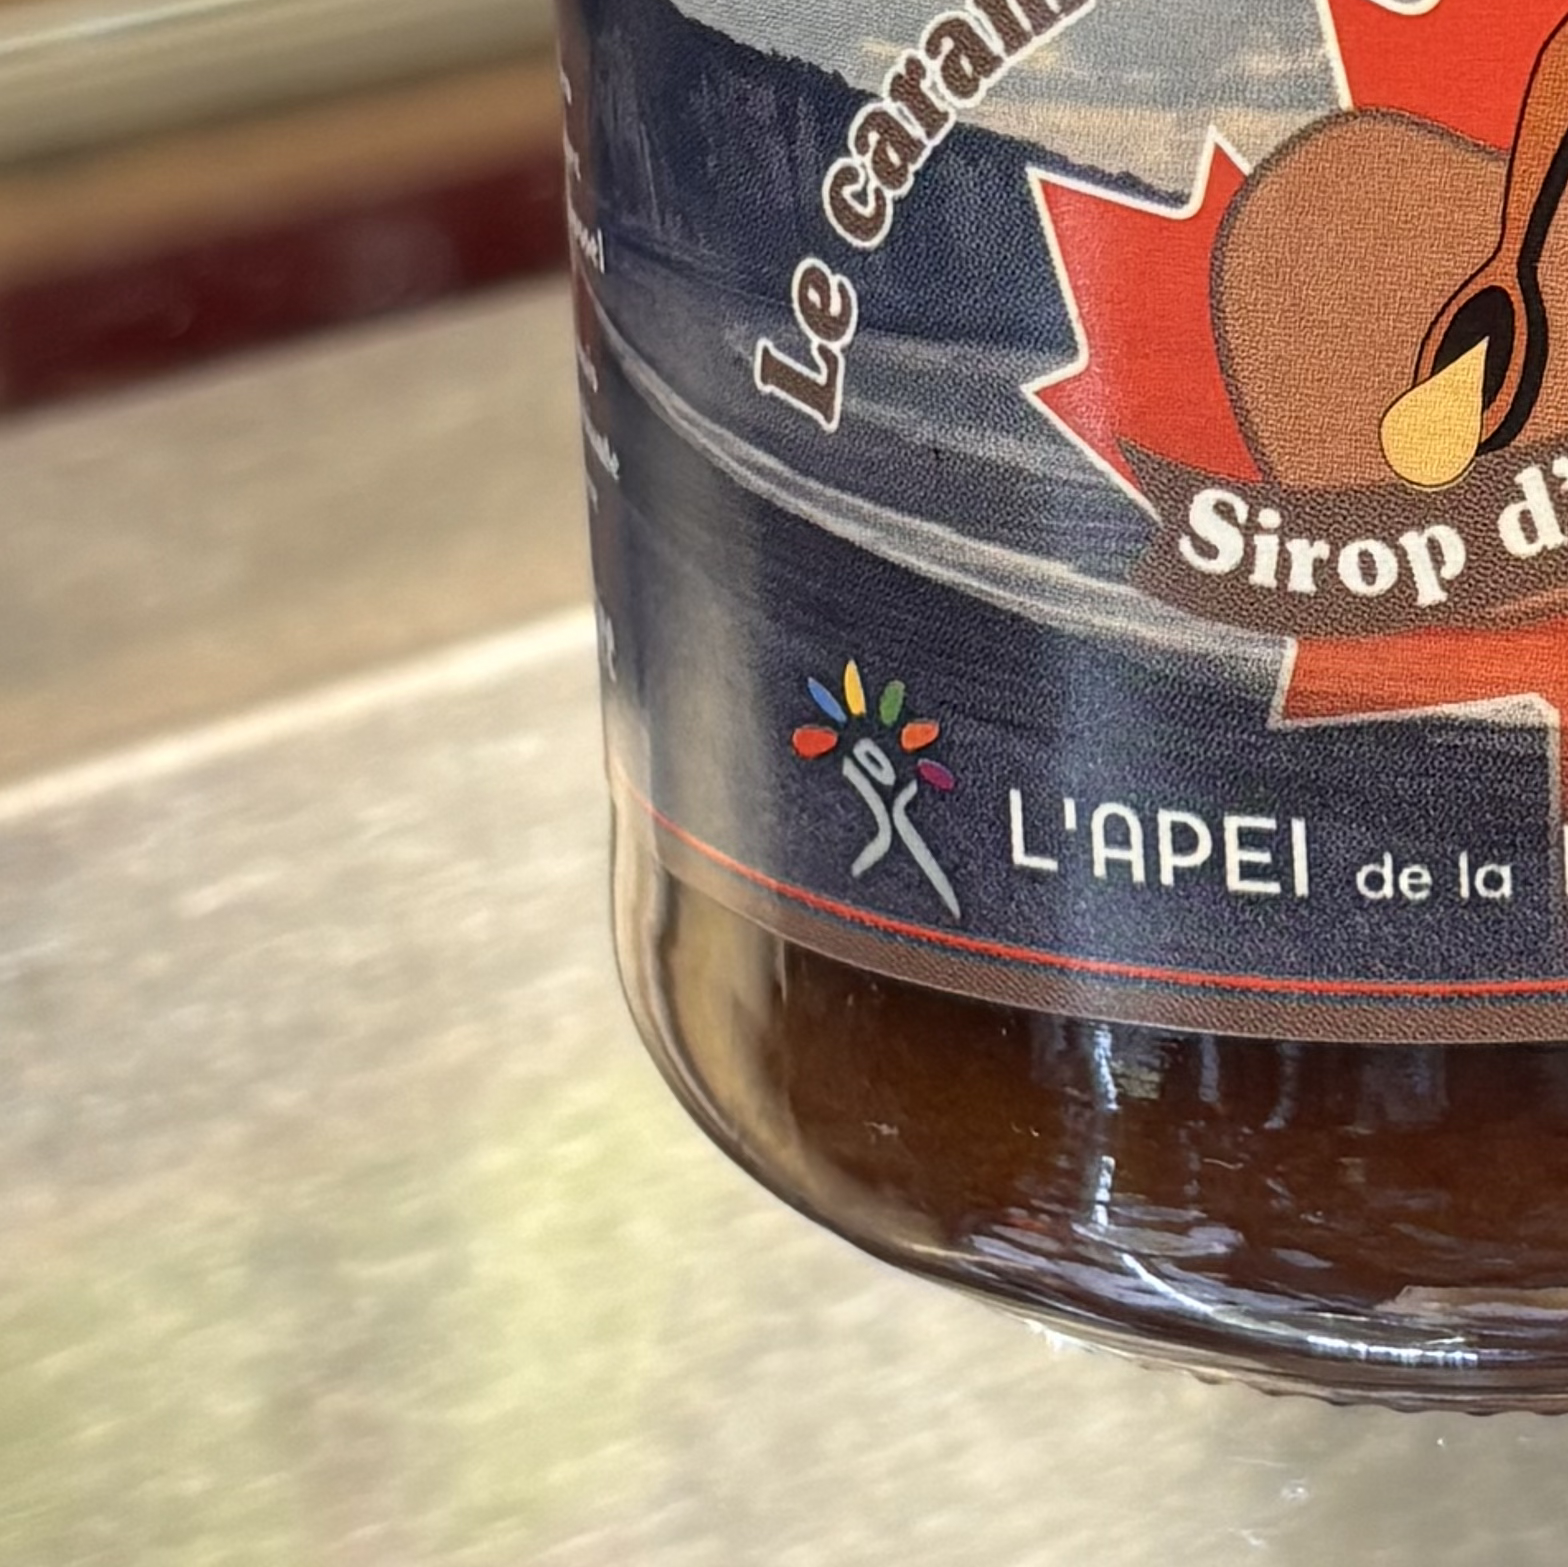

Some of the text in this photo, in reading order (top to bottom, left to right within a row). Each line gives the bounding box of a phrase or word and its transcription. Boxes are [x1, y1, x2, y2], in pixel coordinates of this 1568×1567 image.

[754, 259, 857, 430] Le
[1178, 488, 1466, 608] Sirop
[1009, 789, 1309, 898] L'APEI
[1355, 851, 1433, 900] de
[1459, 851, 1513, 899] la
